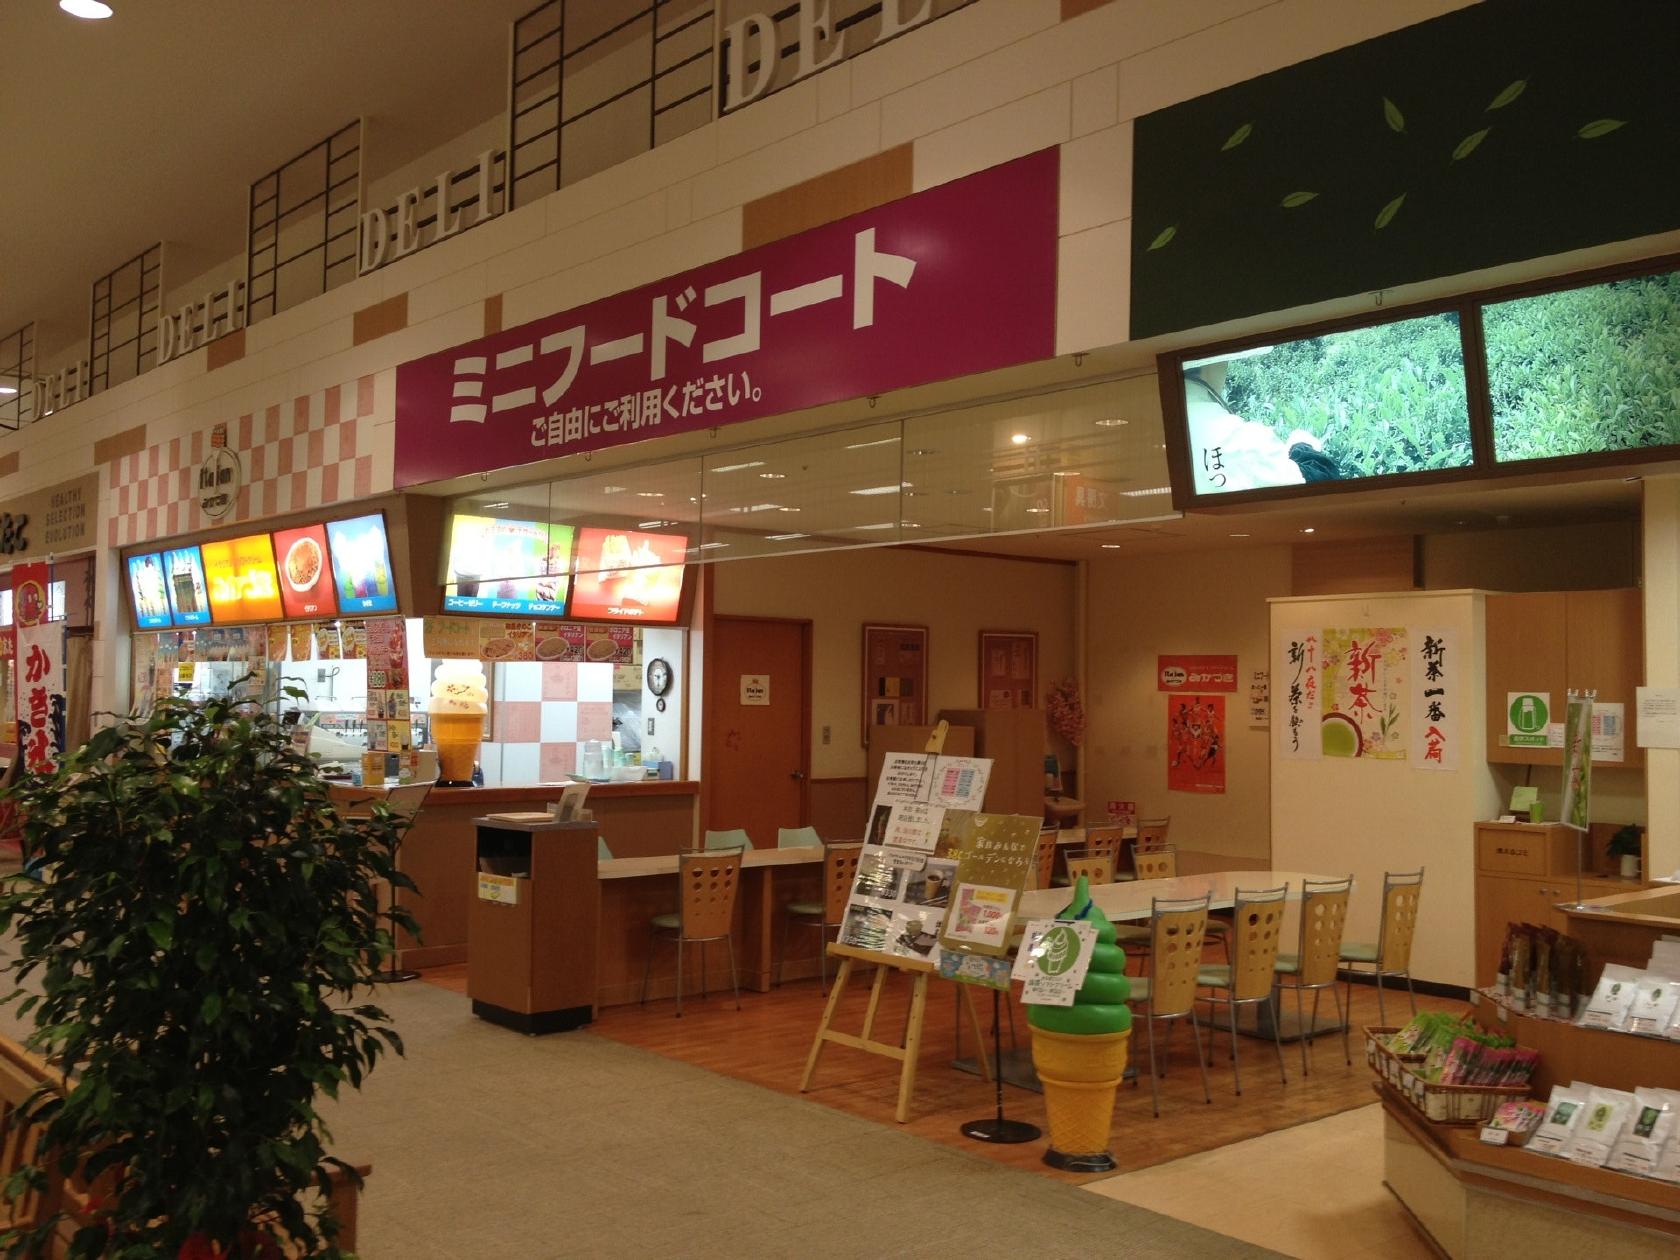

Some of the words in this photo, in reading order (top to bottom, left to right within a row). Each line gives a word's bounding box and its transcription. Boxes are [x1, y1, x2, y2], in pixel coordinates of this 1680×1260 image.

[360, 149, 496, 274] DELI
[157, 279, 242, 366] DELI
[450, 228, 917, 424] ミニフードコート
[530, 371, 762, 447] ご自由にご利用ください。
[1203, 446, 1227, 488] ほっ
[1344, 640, 1382, 725] 新茶
